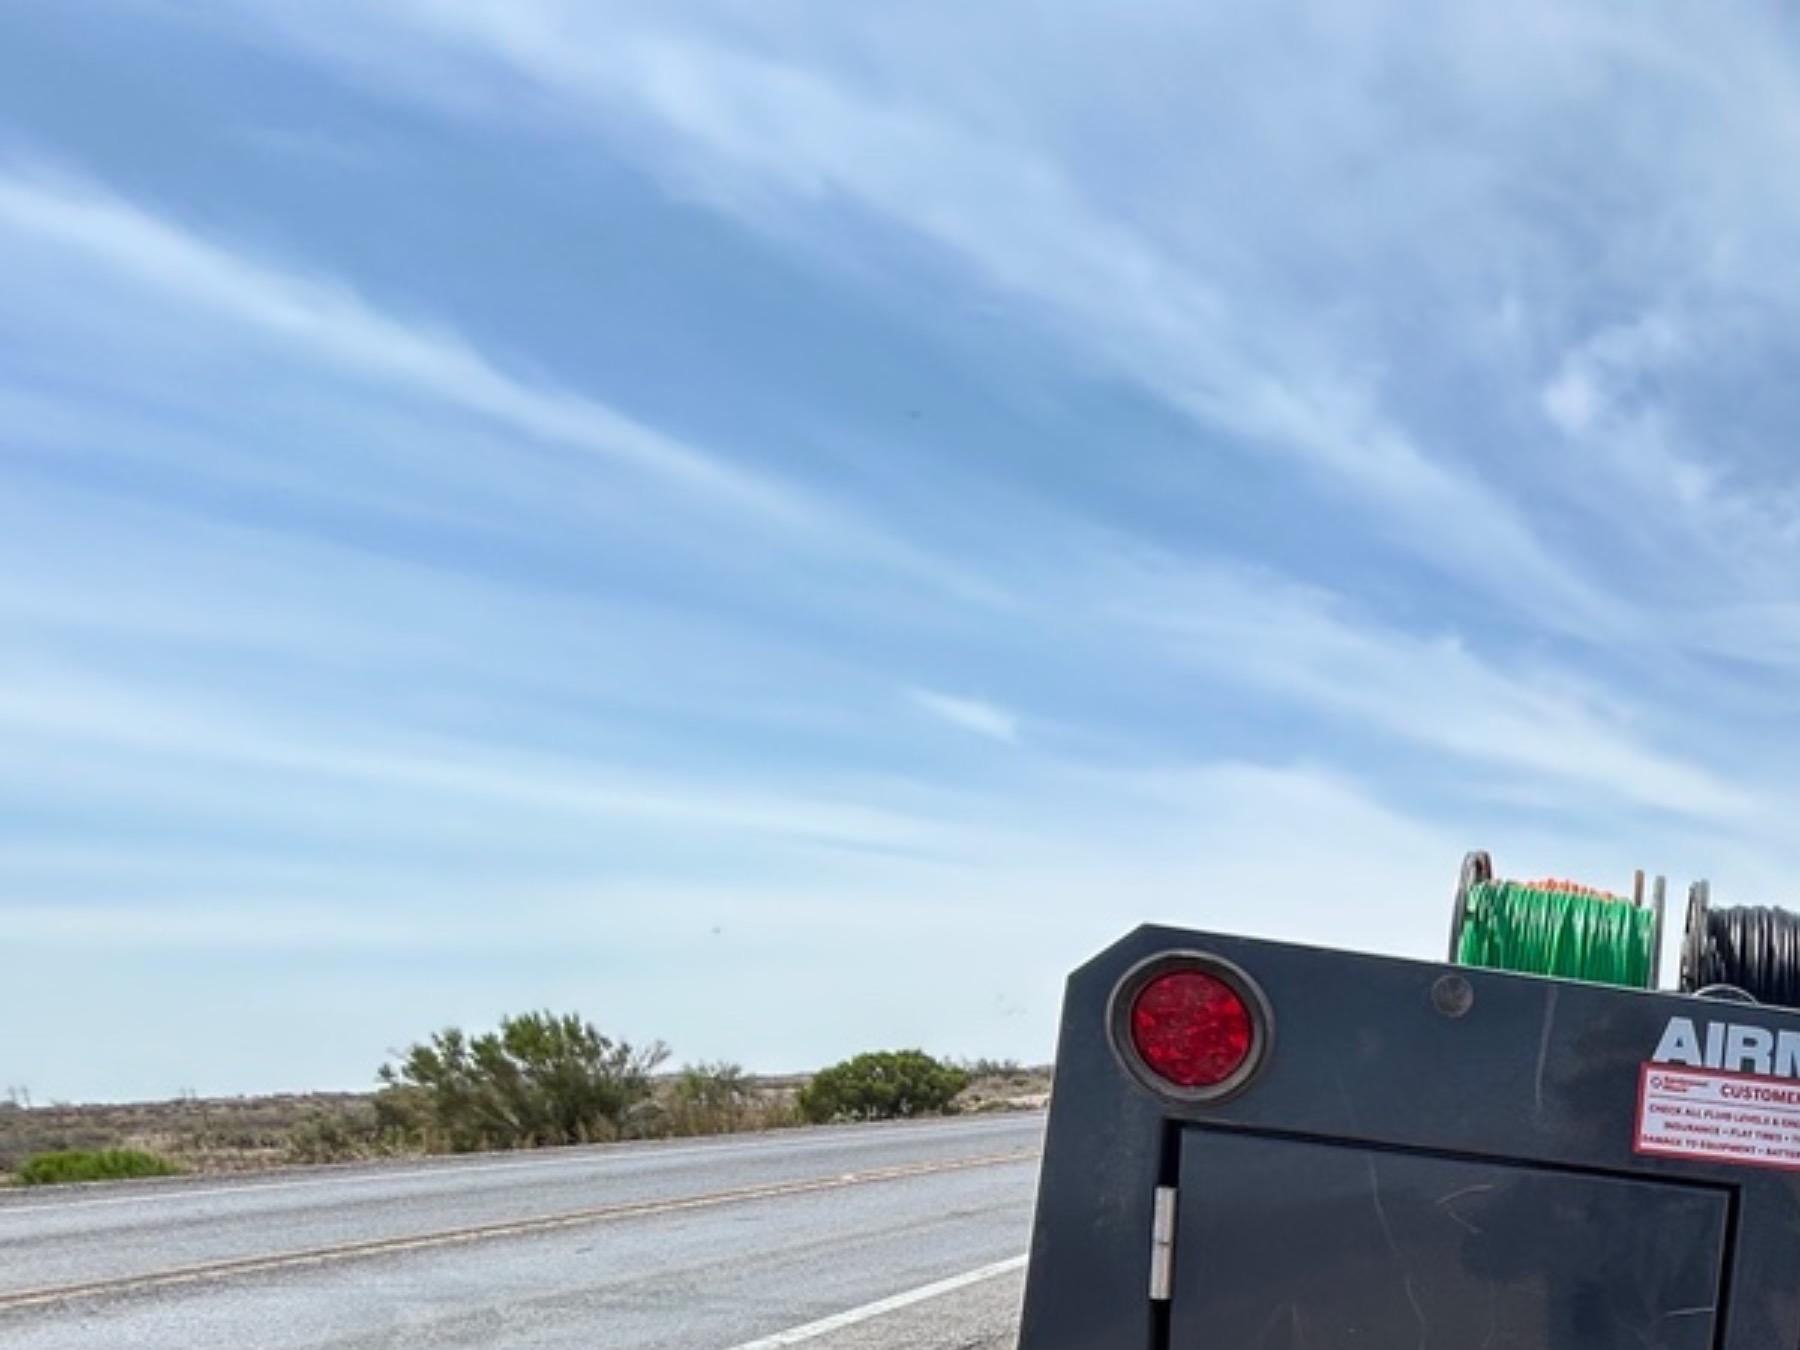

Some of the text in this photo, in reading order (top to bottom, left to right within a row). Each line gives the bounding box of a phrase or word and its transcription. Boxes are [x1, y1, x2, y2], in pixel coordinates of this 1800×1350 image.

[1650, 1103, 1681, 1116] CHECK
[1685, 1106, 1701, 1117] ALL
[1704, 1108, 1732, 1121] FLUID
[1734, 1113, 1770, 1126] LEVELS
[1664, 1121, 1720, 1136] INSURANCE
[1730, 1127, 1753, 1138] FLAT
[1755, 1130, 1783, 1142] TIRES
[1643, 1133, 1681, 1147] DAMAGE
[1686, 1138, 1699, 1148] TO
[1700, 1139, 1757, 1155] EQUIPMENT
